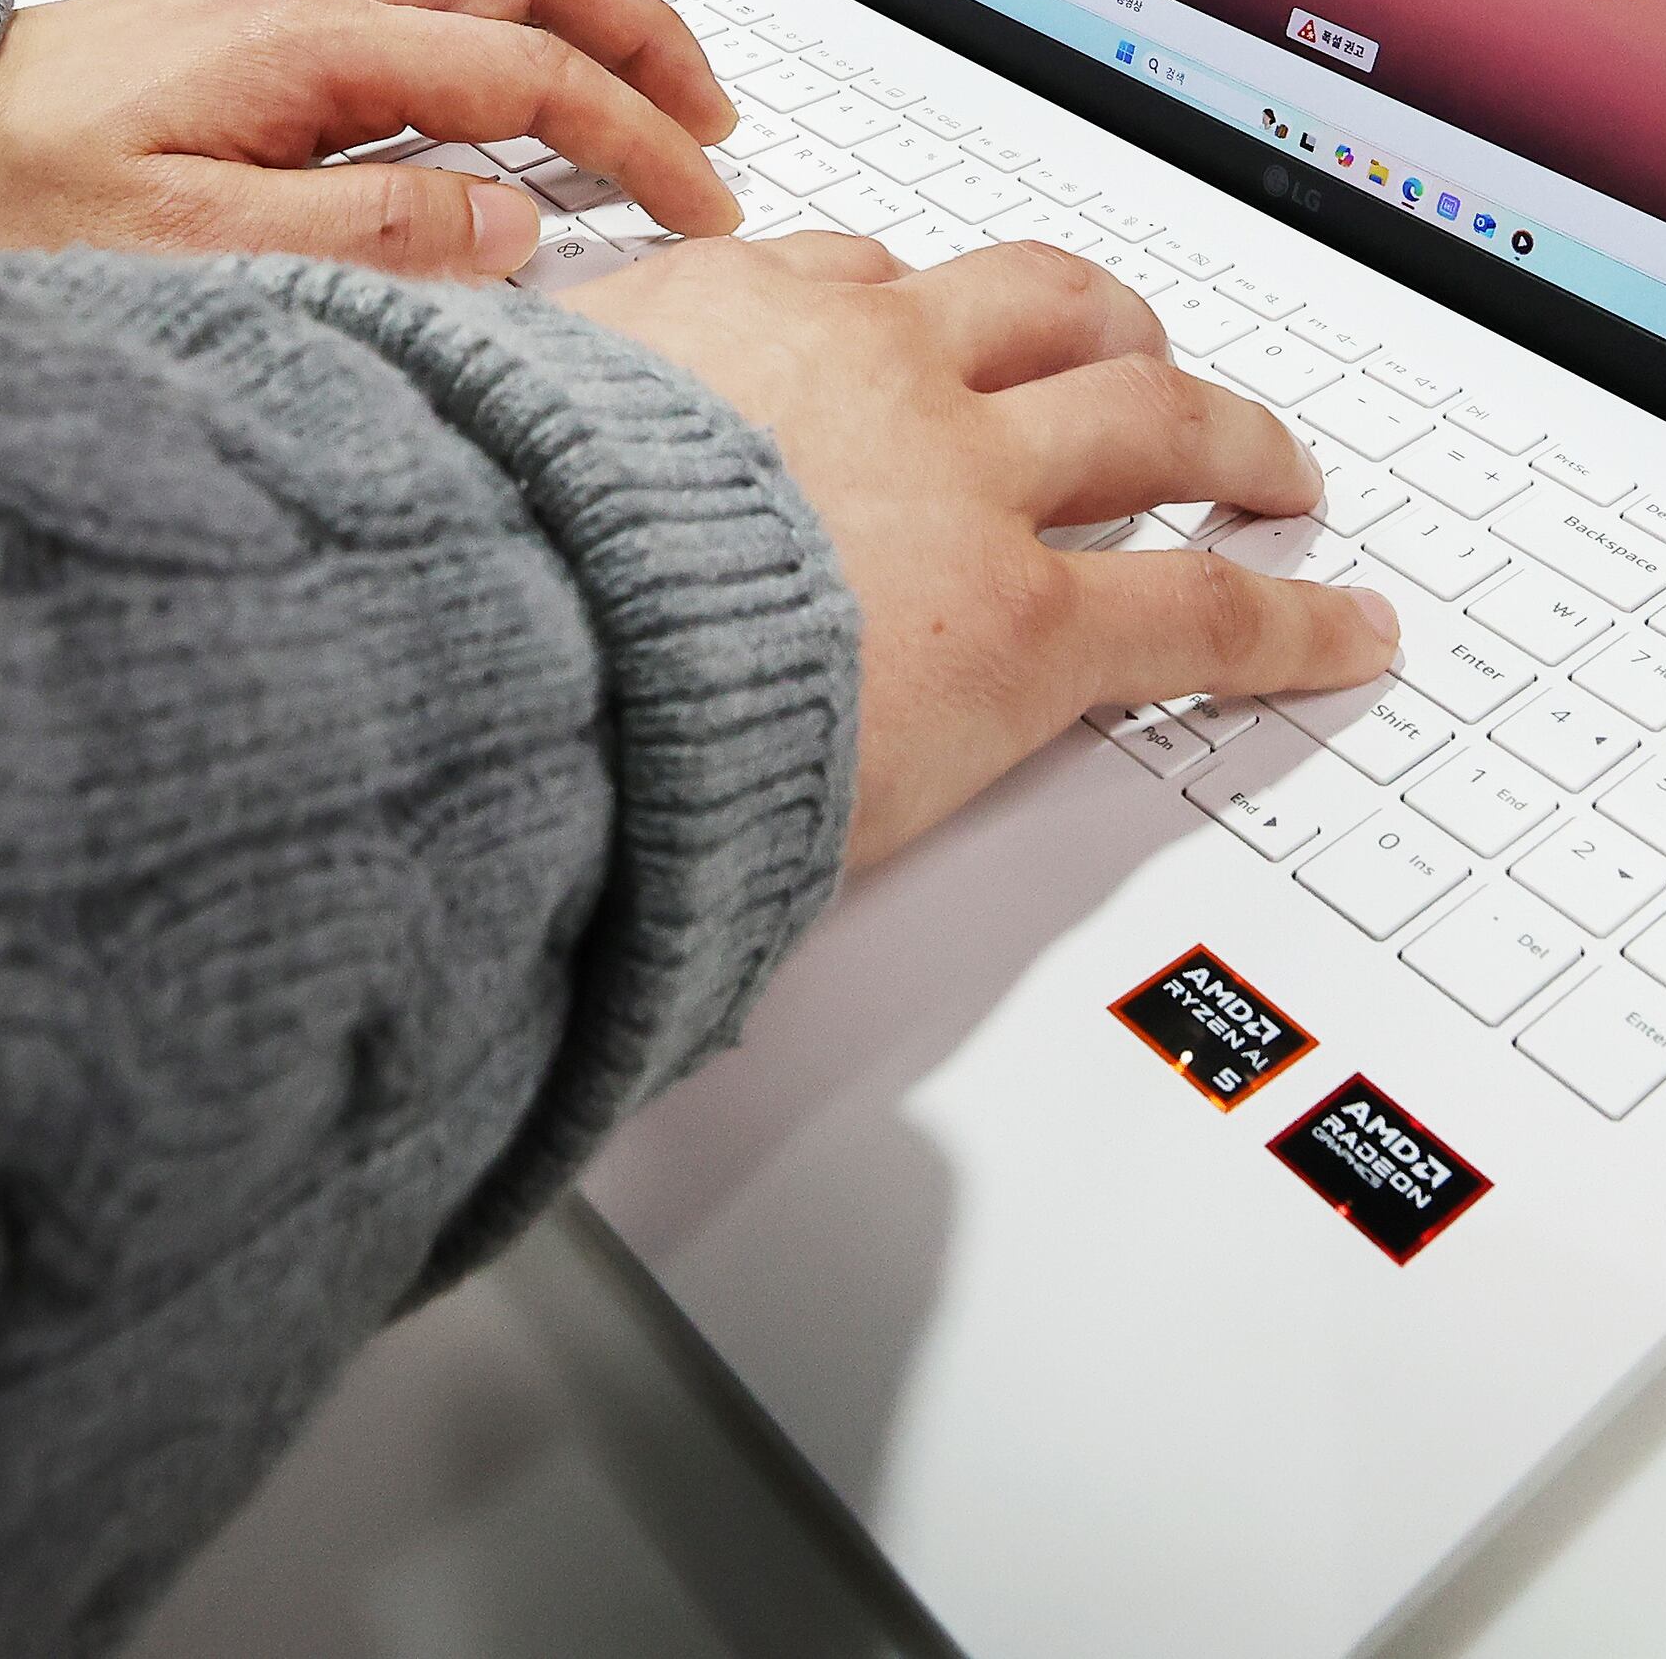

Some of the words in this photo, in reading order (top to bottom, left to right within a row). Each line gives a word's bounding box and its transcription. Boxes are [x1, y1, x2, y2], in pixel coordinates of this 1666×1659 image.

[1321, 28, 1344, 51] 폭설
[1344, 39, 1366, 59] 권고
[1165, 67, 1186, 87] 검색
[1292, 184, 1322, 214] LG
[1307, 317, 1328, 331] F11
[1384, 360, 1407, 374] F12
[1553, 451, 1592, 477] PrtSc
[1562, 513, 1659, 574] Backspace
[1449, 642, 1507, 682] Enter
[1370, 702, 1422, 742] Shift
[1140, 723, 1176, 753] PgDn
[1229, 790, 1259, 817] End
[1495, 787, 1529, 813] End
[1408, 853, 1436, 877] Ins
[1516, 932, 1551, 961] Del
[1182, 966, 1255, 1023] AMD
[1162, 978, 1246, 1051] RYZEN
[1240, 1047, 1271, 1073] AI
[1211, 1066, 1242, 1093] 5
[1340, 1099, 1422, 1164] AMD
[1321, 1112, 1433, 1210] RADEON
